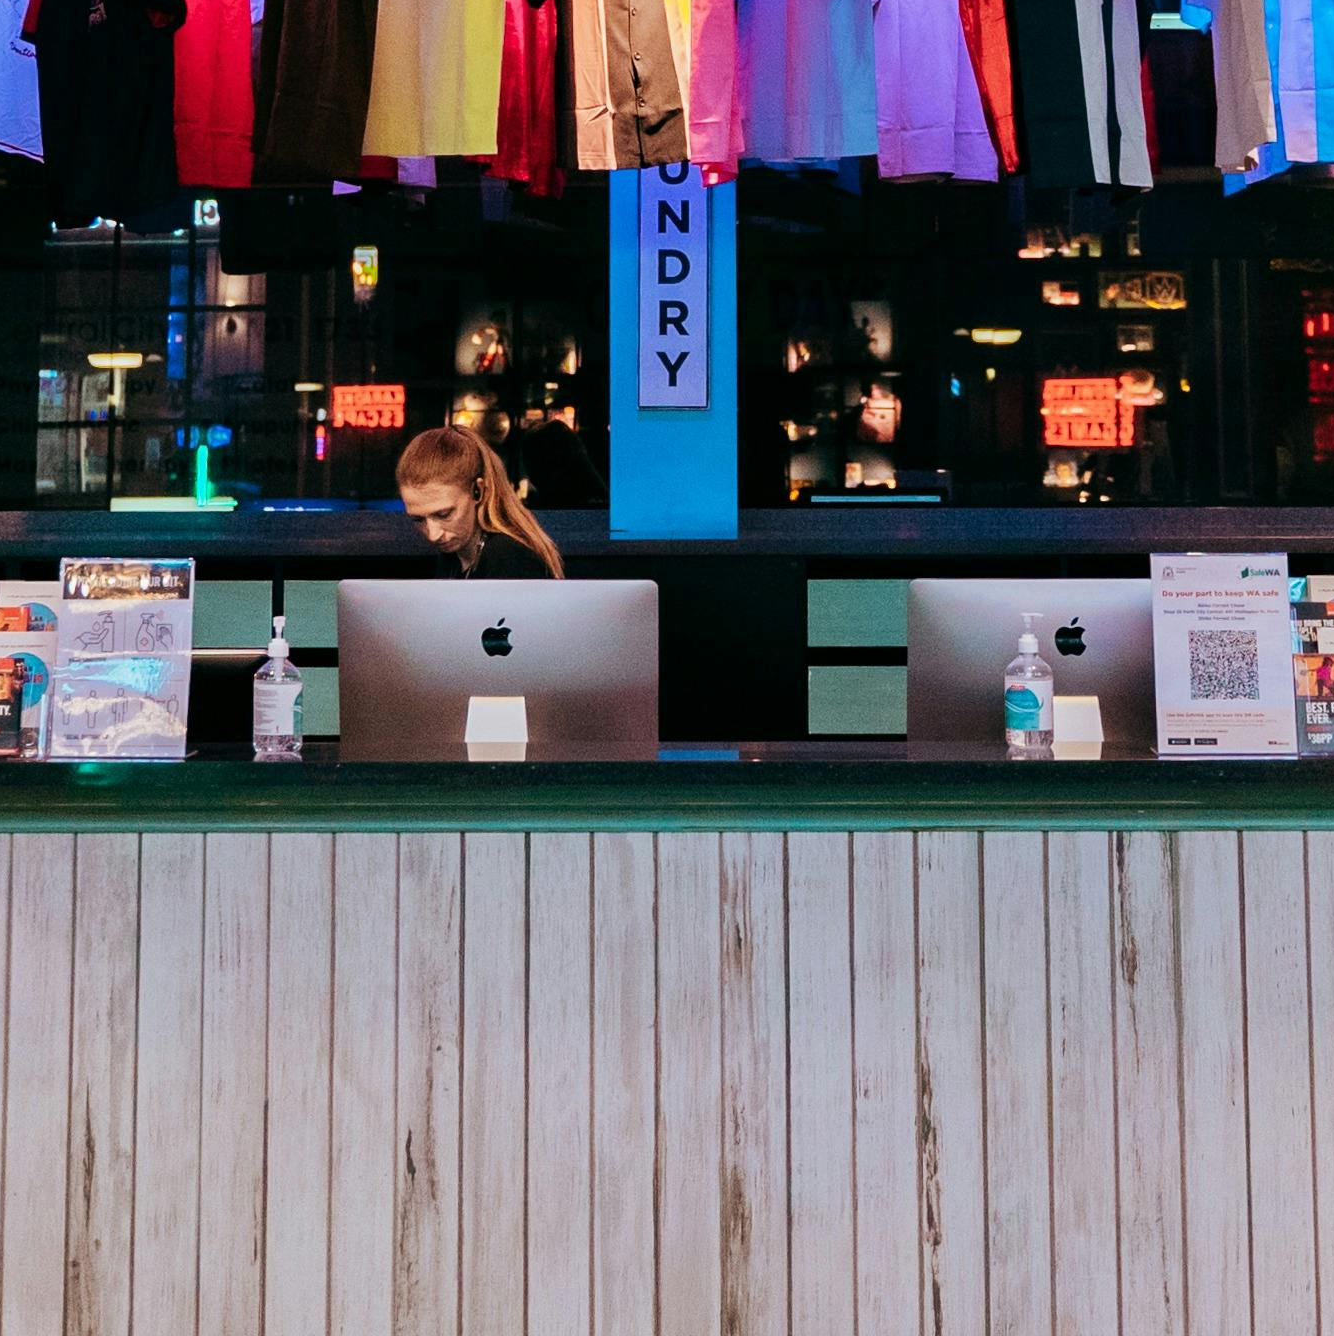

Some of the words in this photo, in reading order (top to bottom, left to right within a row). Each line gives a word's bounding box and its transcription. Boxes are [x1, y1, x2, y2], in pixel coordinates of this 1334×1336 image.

[1250, 568, 1280, 577] SafeWA
[1196, 590, 1212, 598] part
[1225, 590, 1244, 598] keep
[1306, 701, 1330, 713] BEST.
[1307, 713, 1332, 724] EVER.
